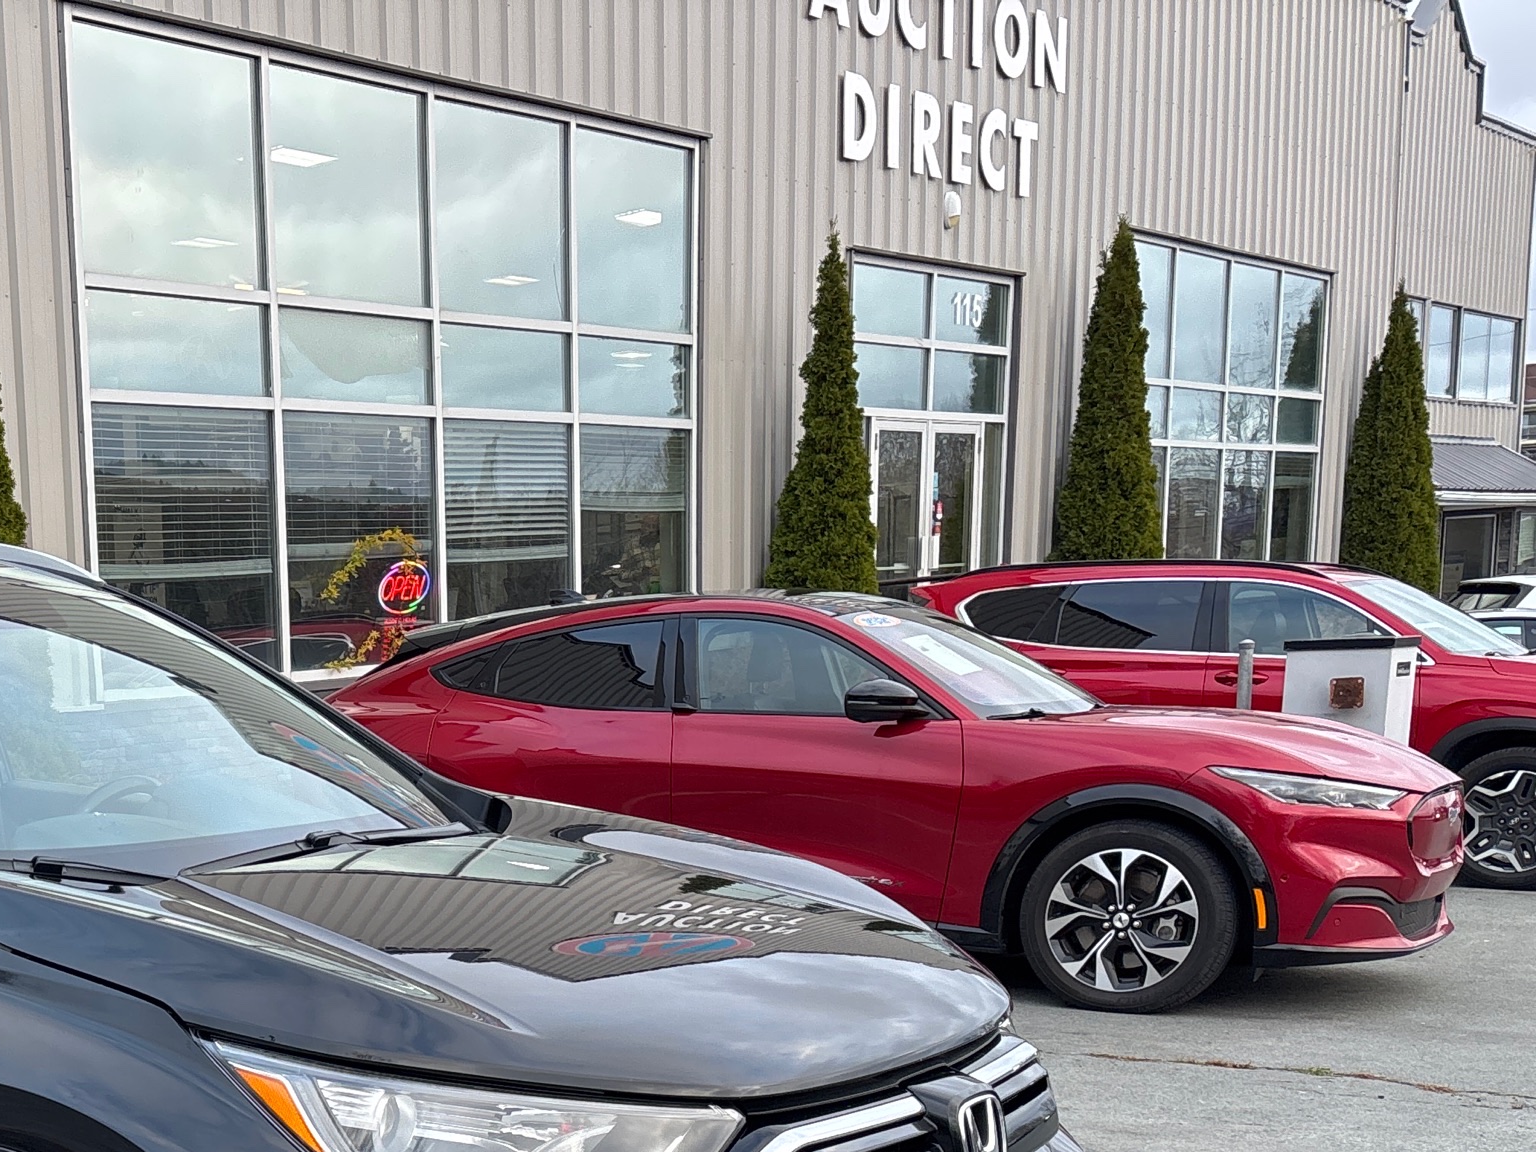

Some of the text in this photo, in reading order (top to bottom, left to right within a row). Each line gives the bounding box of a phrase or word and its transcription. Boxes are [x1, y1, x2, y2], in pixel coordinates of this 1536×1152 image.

[809, 0, 1068, 94] CTION
[843, 70, 1039, 198] DIRECT
[952, 292, 982, 328] 115
[381, 575, 426, 601] OPEN
